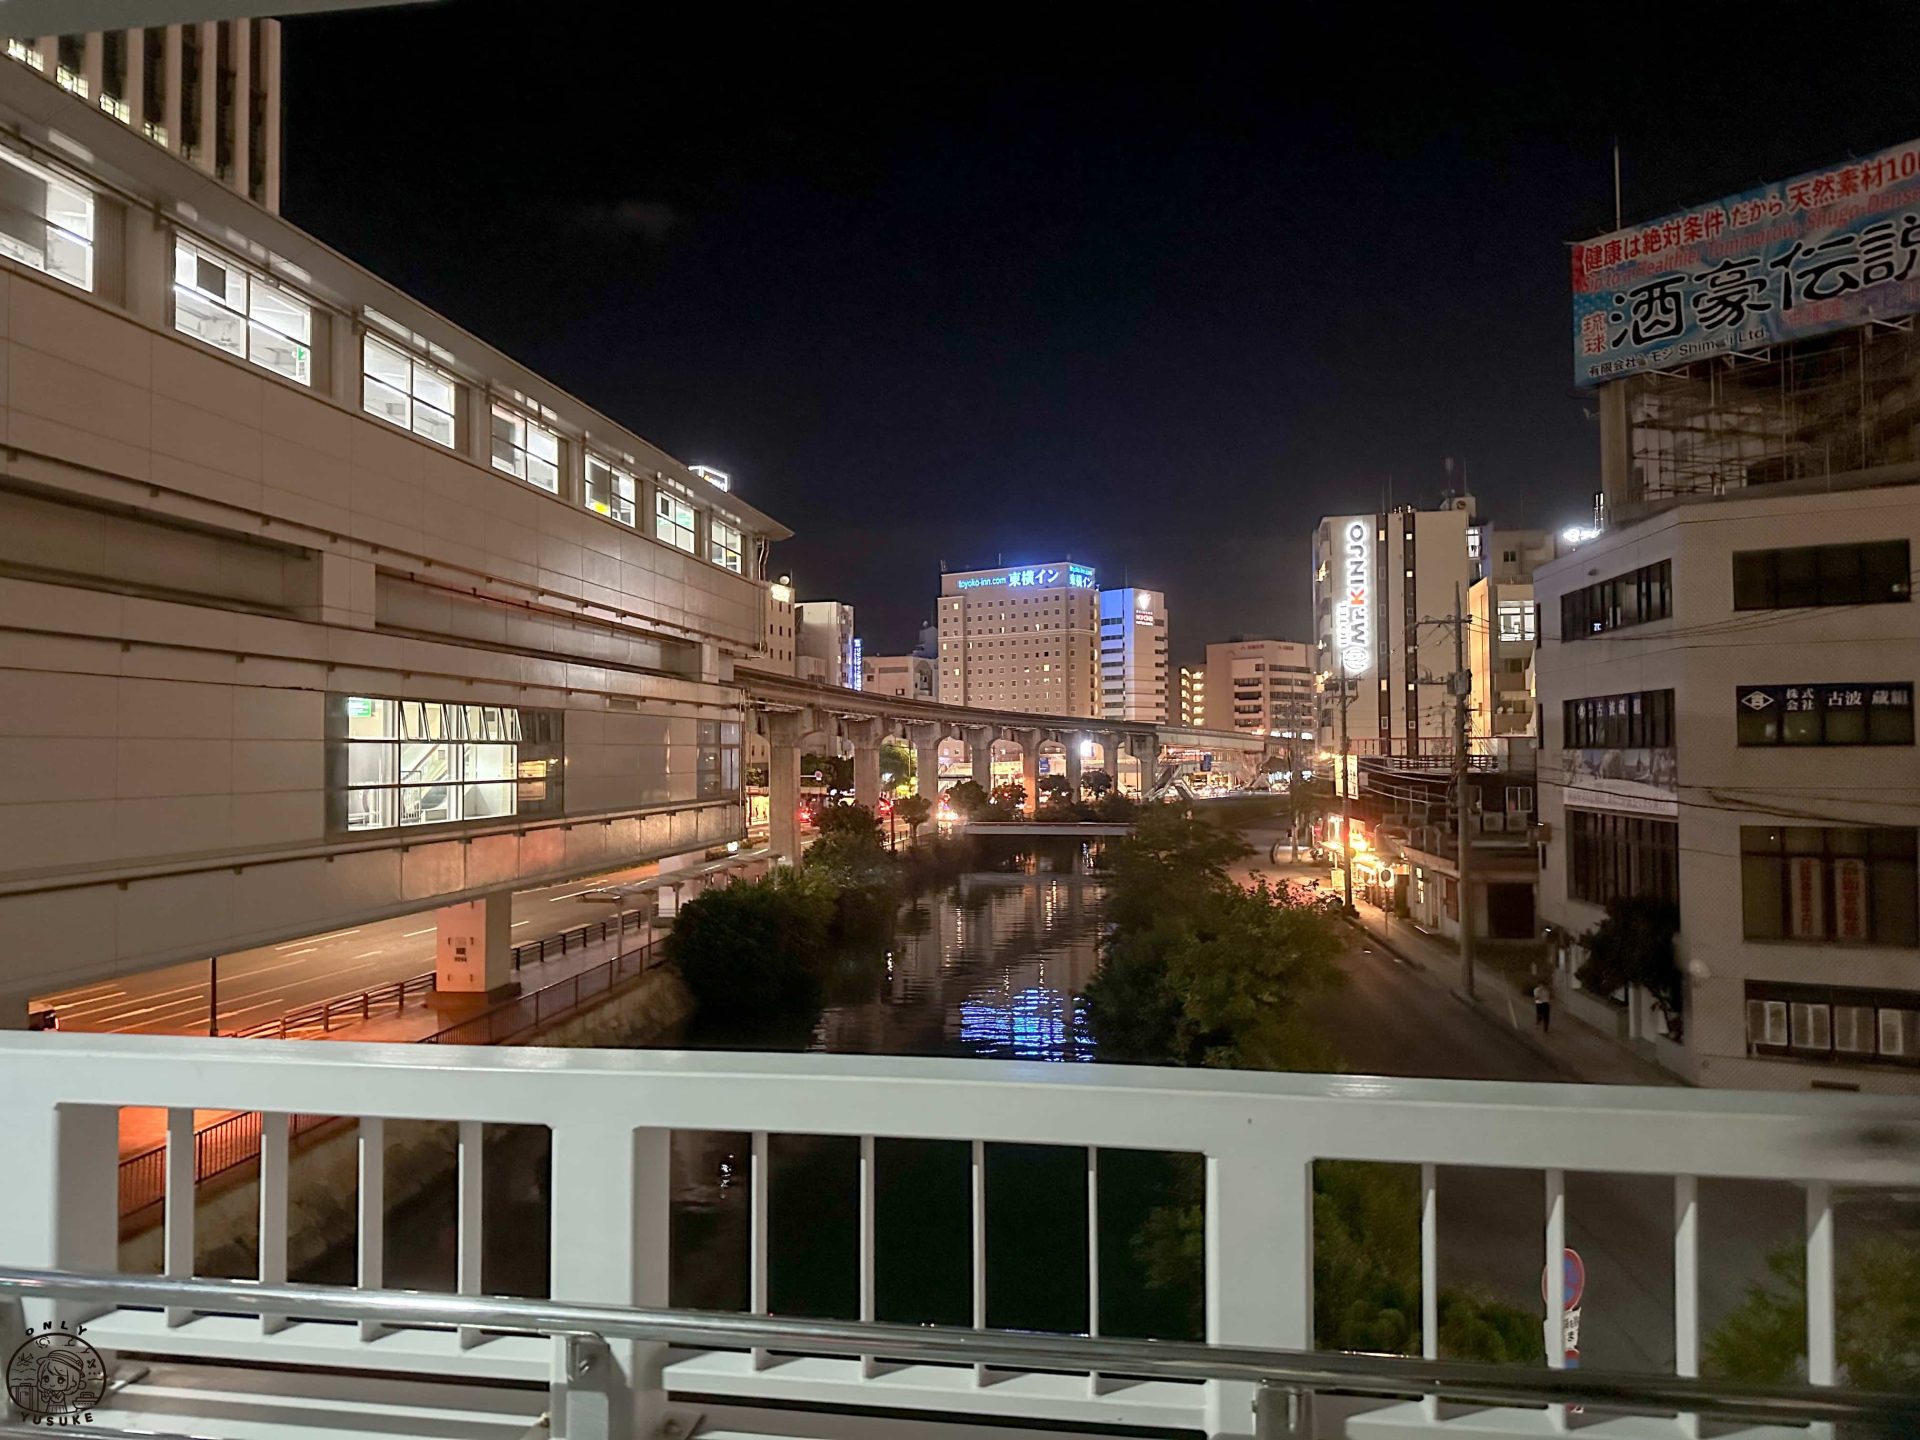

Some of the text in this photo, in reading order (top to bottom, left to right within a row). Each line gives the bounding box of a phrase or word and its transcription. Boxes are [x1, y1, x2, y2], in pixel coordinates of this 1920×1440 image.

[1731, 195, 1783, 226] だから
[1788, 150, 1920, 213] 天然素材10
[1008, 568, 1059, 587] 東横イン
